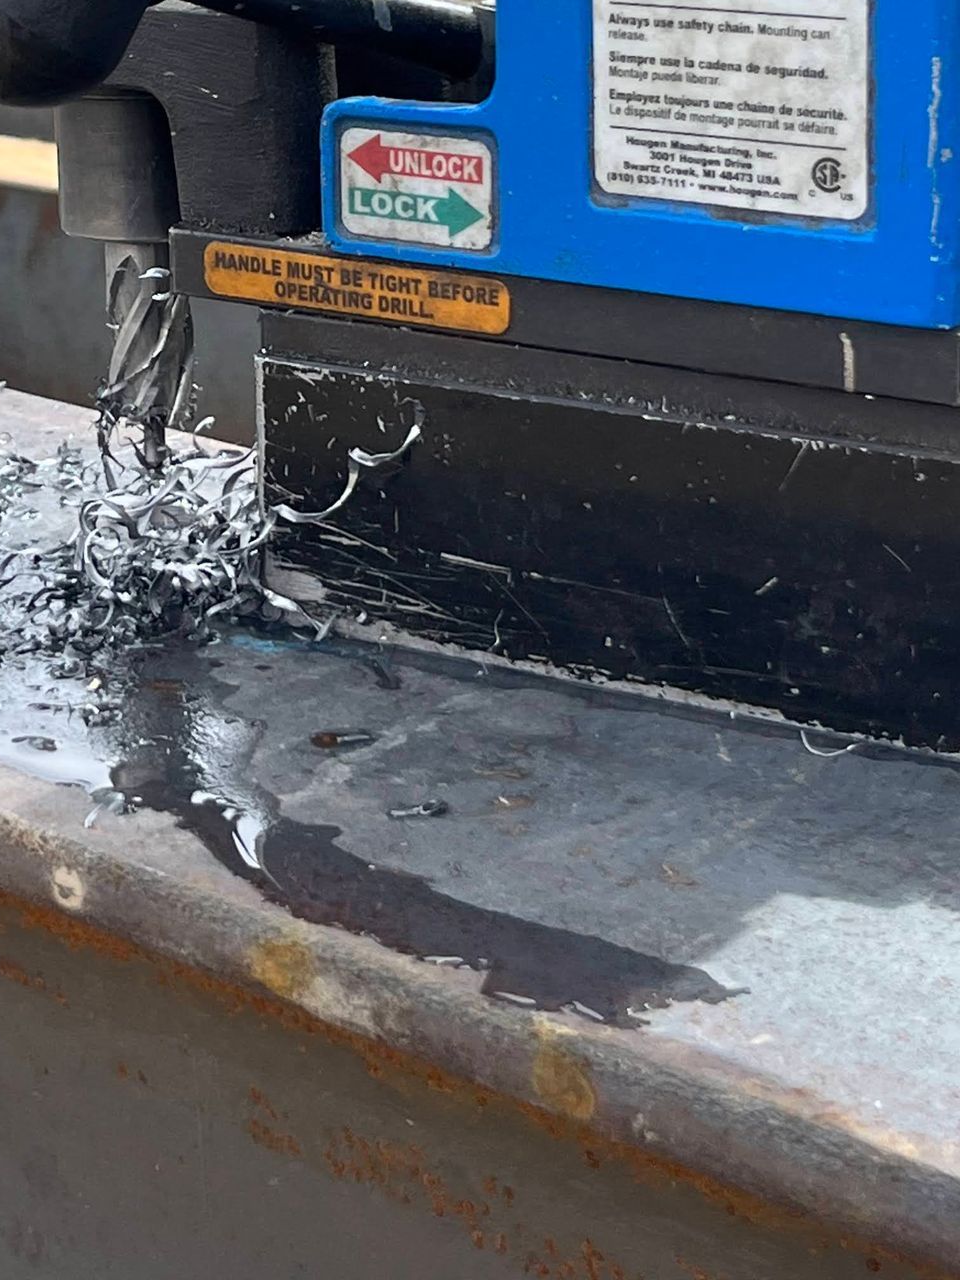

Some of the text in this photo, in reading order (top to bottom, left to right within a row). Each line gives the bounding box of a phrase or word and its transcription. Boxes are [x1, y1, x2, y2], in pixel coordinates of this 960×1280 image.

[608, 13, 830, 41] Always use safety chain. Mounting can
[608, 29, 648, 41] release.
[609, 51, 828, 79] Siempre use la cadena de seguridad.
[389, 149, 480, 181] UNLOCK
[353, 191, 439, 220] LOCK
[214, 251, 499, 306] HANDLE MUST BE TIGHT BEFORE
[274, 281, 434, 319] OPERATING DRILL.
